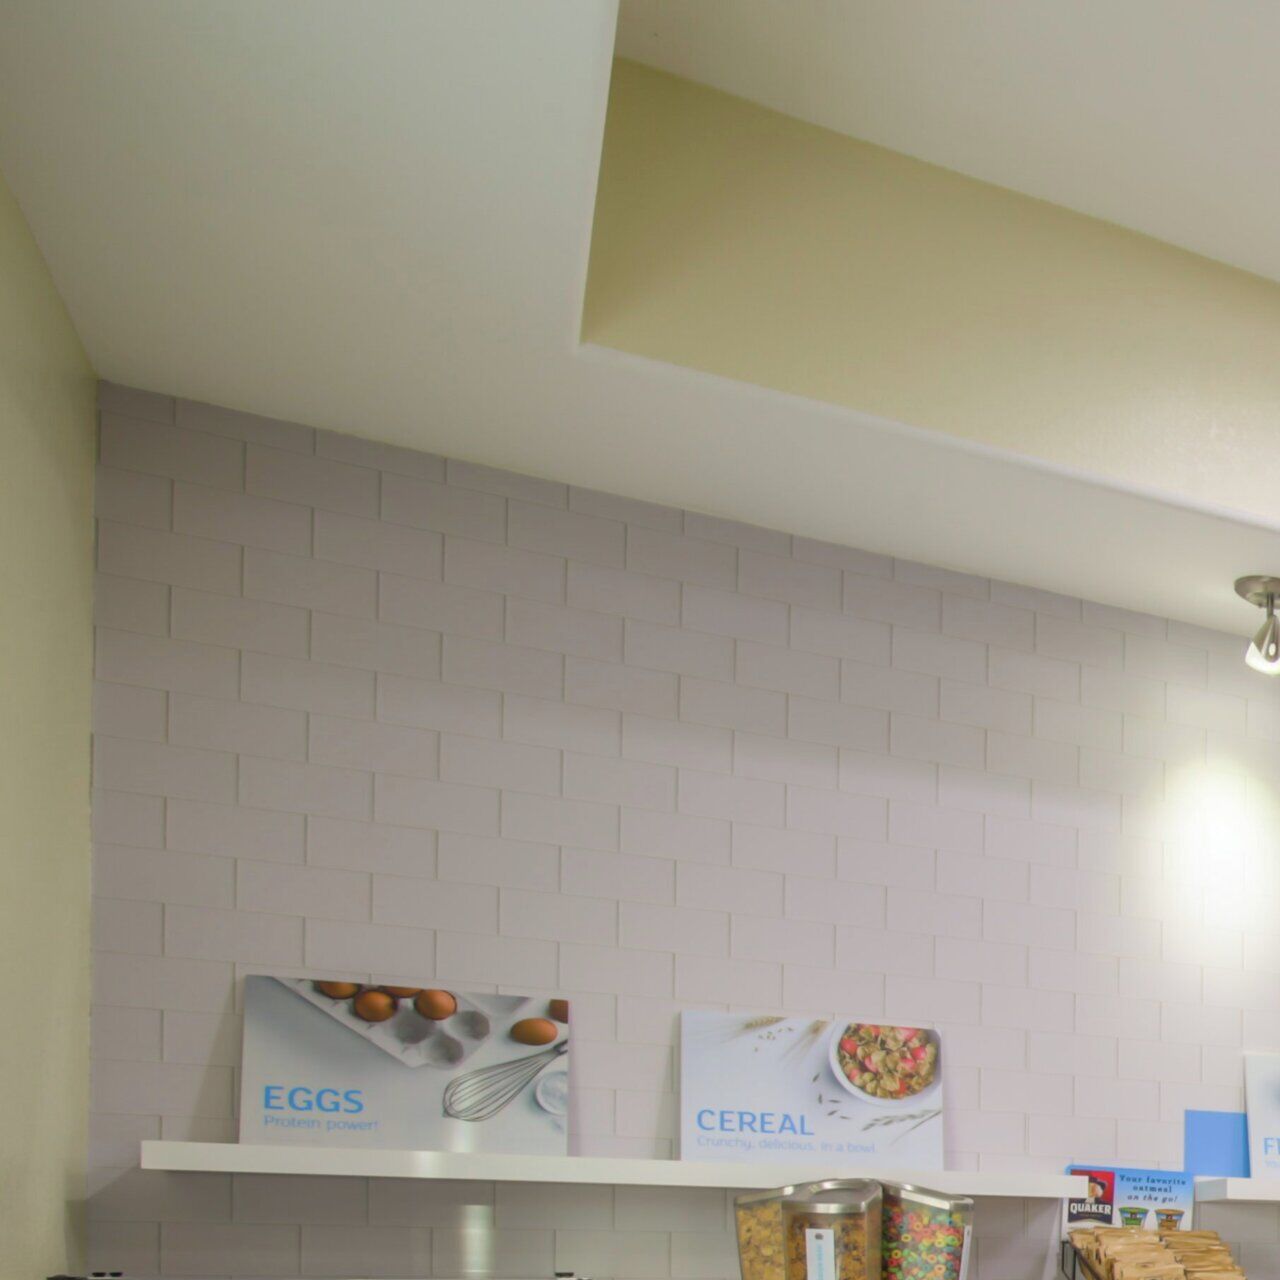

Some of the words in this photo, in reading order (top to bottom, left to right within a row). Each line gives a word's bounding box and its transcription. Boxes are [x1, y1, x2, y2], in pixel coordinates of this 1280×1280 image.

[264, 1085, 364, 1113] EGGS
[264, 1115, 321, 1129] Protein
[697, 1109, 815, 1136] CEREAL
[1119, 1173, 1143, 1182] Your
[1146, 1175, 1187, 1186] favorite
[1133, 1184, 1172, 1193] oatmeal
[1143, 1194, 1158, 1202] the
[1069, 1202, 1112, 1215] QUAKER
